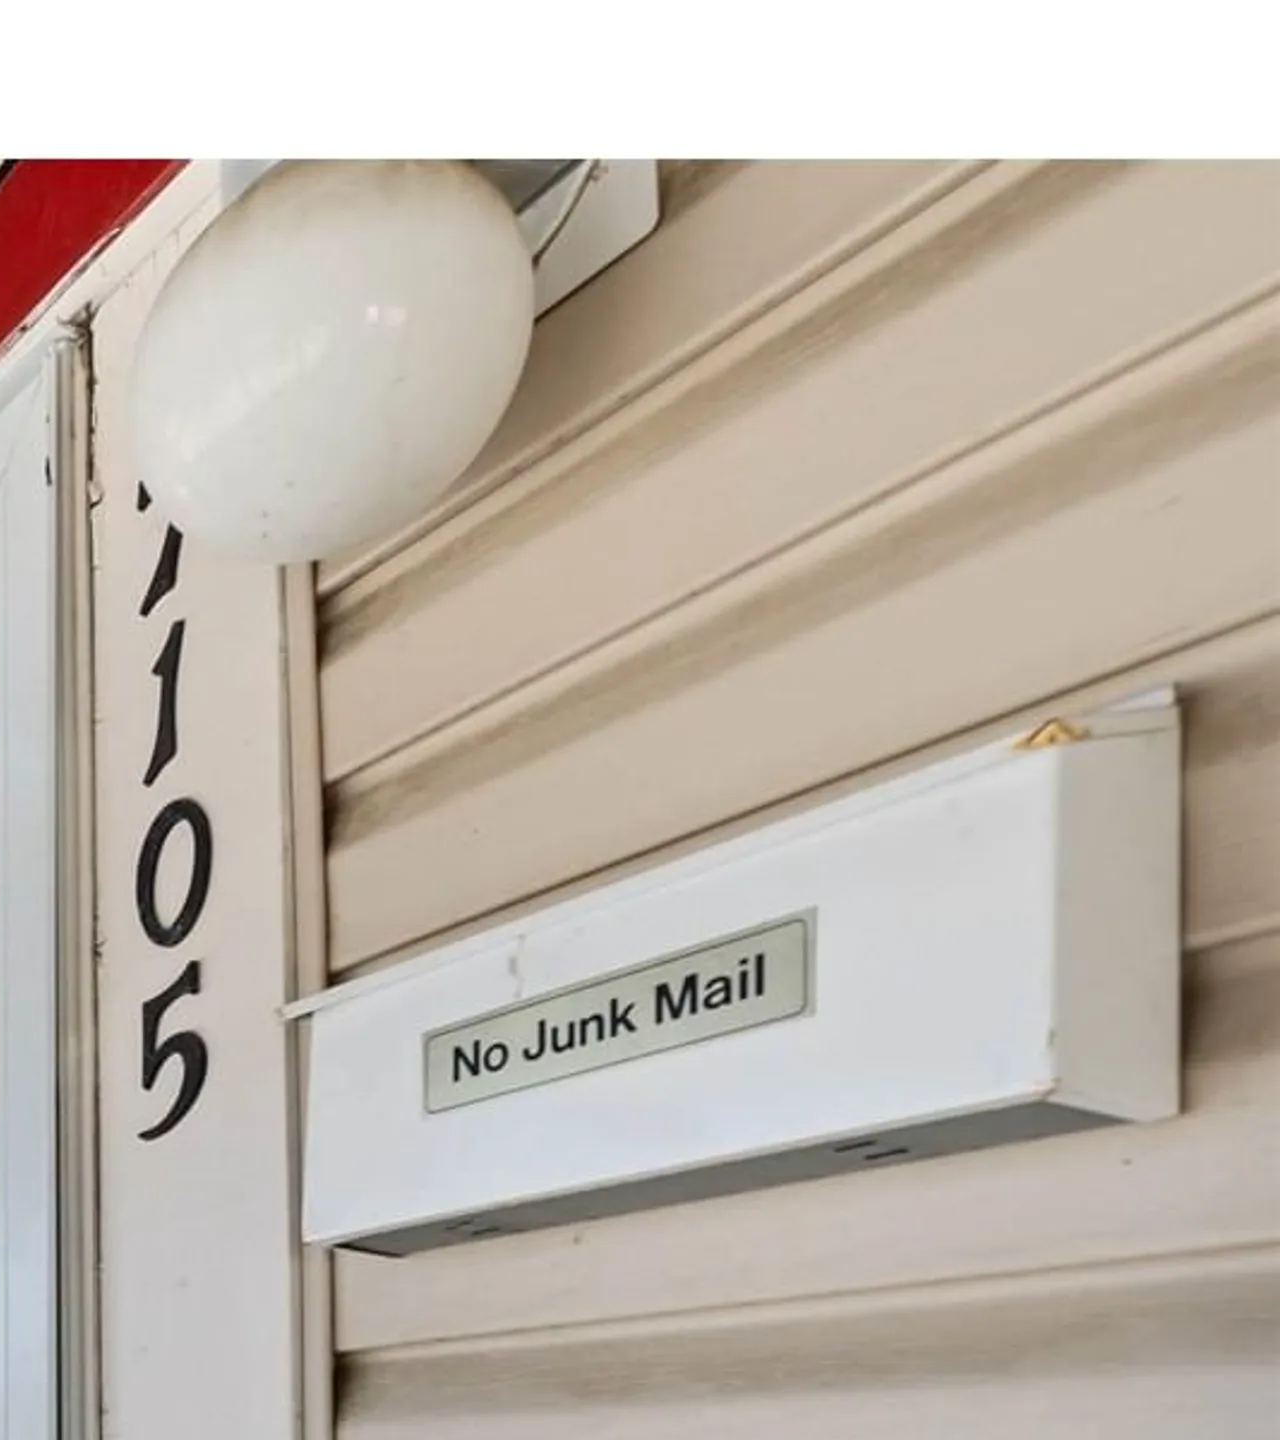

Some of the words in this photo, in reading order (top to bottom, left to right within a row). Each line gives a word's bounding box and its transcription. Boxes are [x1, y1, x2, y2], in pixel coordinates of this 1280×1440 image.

[452, 1039, 510, 1083] No
[522, 998, 638, 1061] Junk
[654, 952, 766, 1026] Mail
